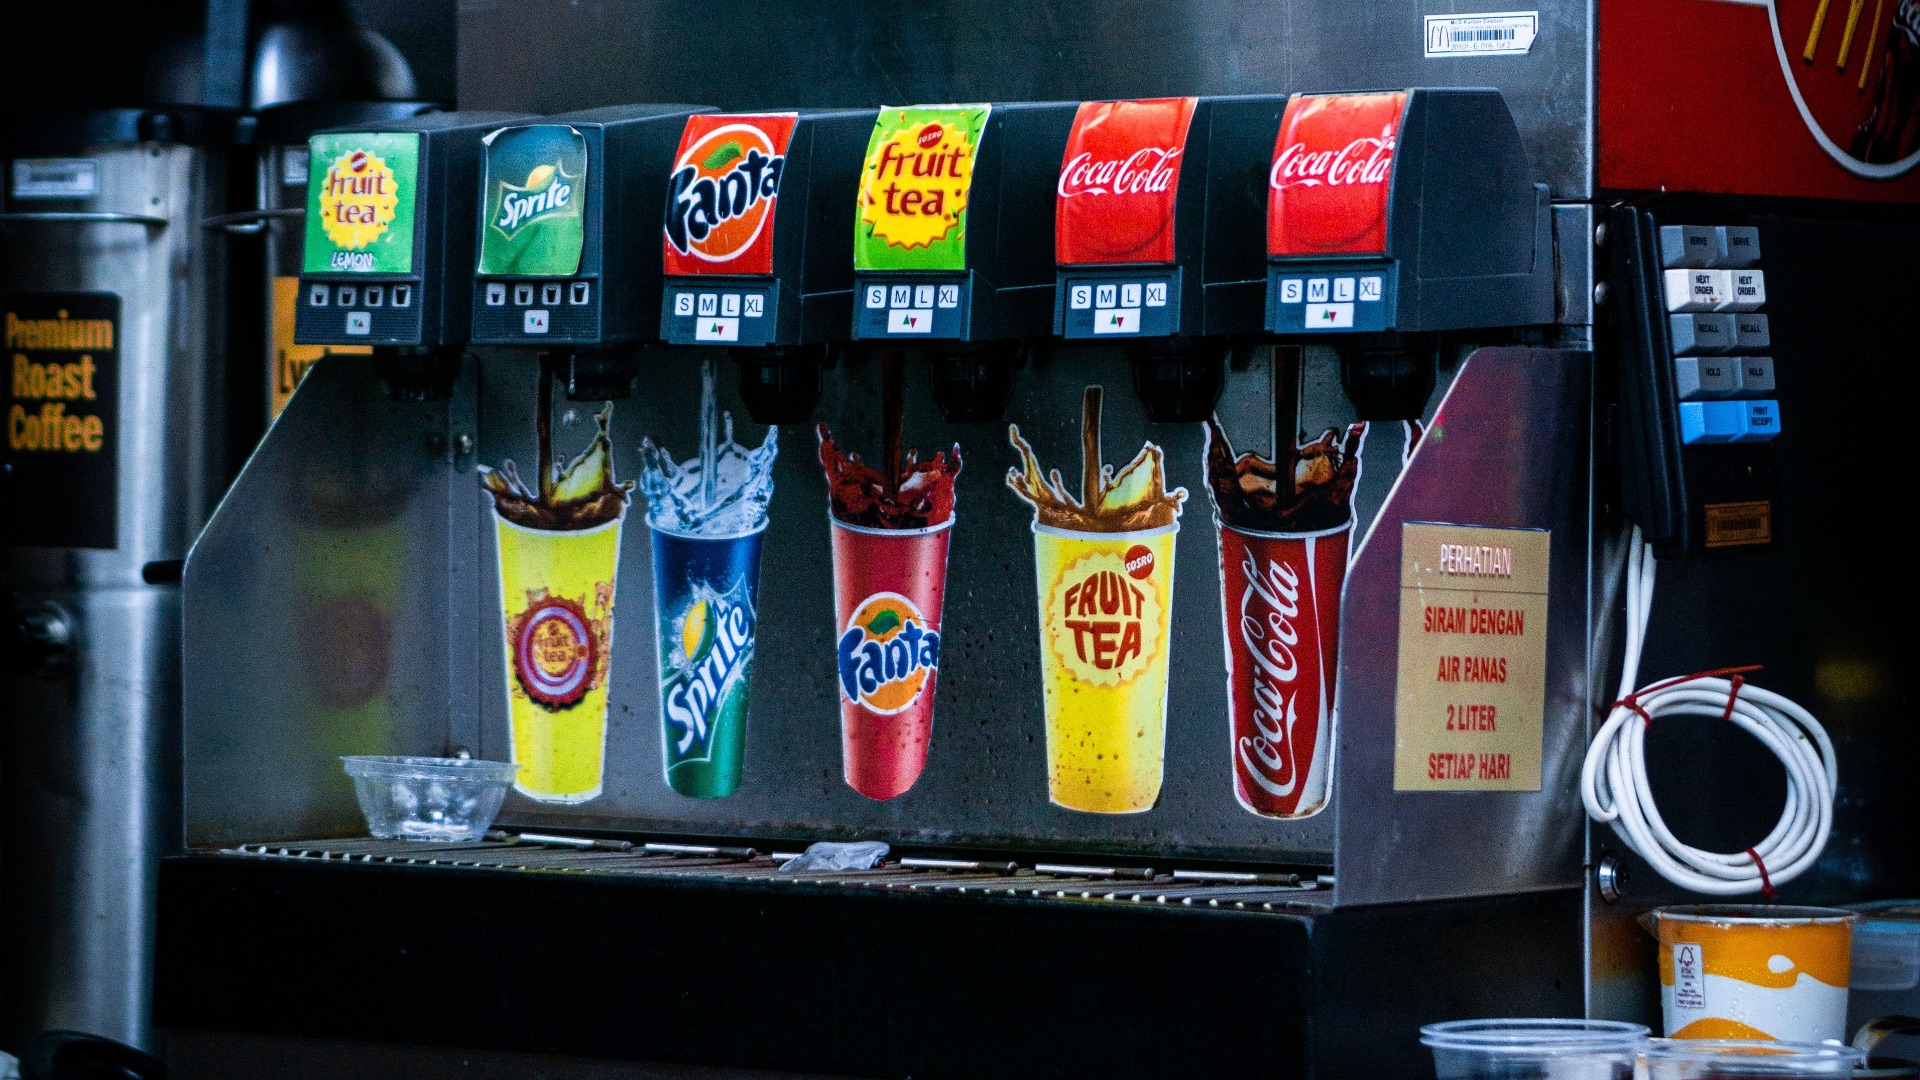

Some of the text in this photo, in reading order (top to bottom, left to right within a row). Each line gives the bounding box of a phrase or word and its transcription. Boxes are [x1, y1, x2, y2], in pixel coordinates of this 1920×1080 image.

[918, 130, 943, 144] SOSRO
[877, 142, 965, 180] fruit
[1057, 147, 1184, 197] Coca-Cola
[1269, 137, 1397, 188] Coca-Cola
[329, 167, 388, 197] fruit
[334, 200, 376, 224] tea
[499, 171, 571, 228] Sprite
[665, 149, 785, 254] Fanta
[882, 181, 945, 216] tea
[331, 251, 373, 269] LEMON
[1286, 281, 1381, 299] S M L XL
[1694, 285, 1714, 295] ORDER
[1695, 275, 1711, 284] NEXT
[1737, 286, 1757, 296] ORDER
[1738, 276, 1753, 285] NEXT
[680, 297, 763, 313] S M L XL
[871, 289, 957, 304] S M L XL
[1076, 287, 1166, 305] S M L XL
[5, 308, 113, 349] Premium
[11, 353, 97, 398] Roast
[8, 402, 103, 451] Coffee
[1125, 552, 1153, 573] SOSRO
[1440, 543, 1512, 577] PERHATIAN
[1064, 570, 1146, 619] FRUIT
[1424, 606, 1524, 636] SIRAM DENGAN
[1064, 619, 1142, 670] TEA
[838, 621, 940, 703] Fanta
[1238, 545, 1299, 797] Coca-Cola
[1437, 656, 1507, 683] AIR PANAS
[667, 600, 751, 755] Sprite
[1446, 704, 1496, 731] 2 LITER
[1427, 753, 1511, 779] SETIAP HARI
